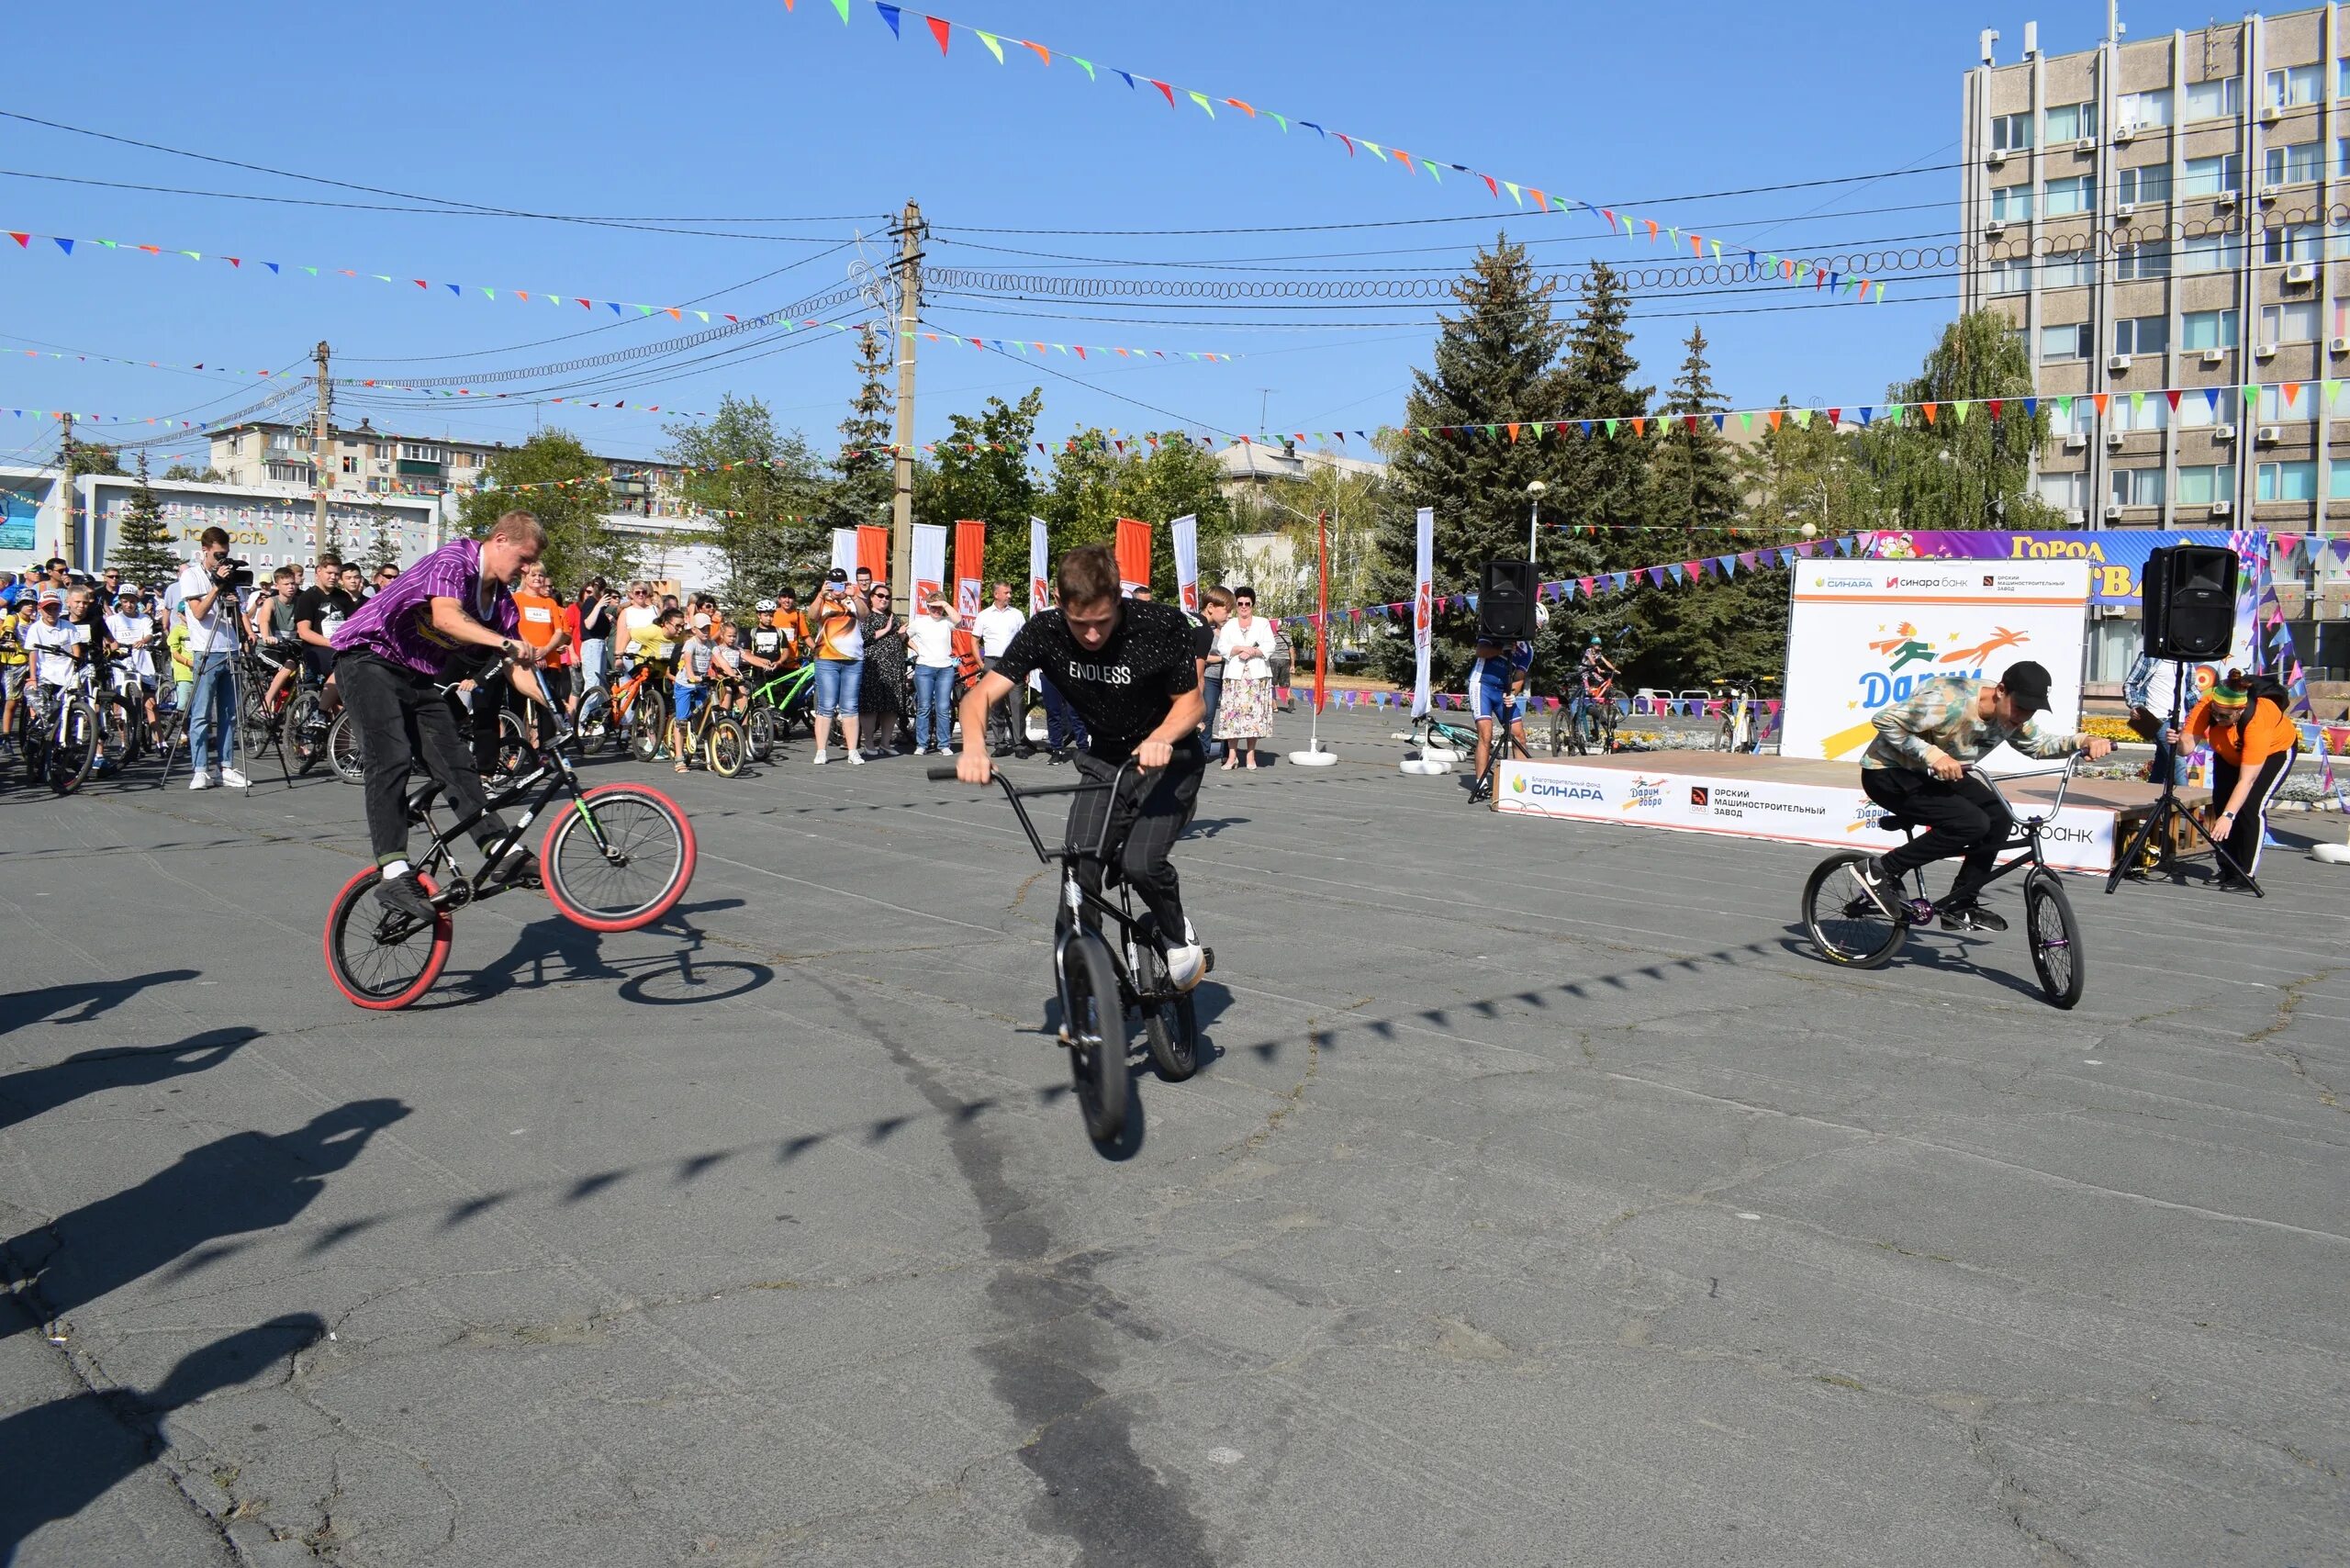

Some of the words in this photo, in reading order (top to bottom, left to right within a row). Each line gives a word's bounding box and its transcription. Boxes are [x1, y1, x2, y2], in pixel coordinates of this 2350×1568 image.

[1827, 580, 1874, 588] СИНАРА
[1899, 578, 1941, 588] синара
[1941, 577, 1968, 588] банк
[1069, 661, 1132, 685] ENDLESS
[1531, 784, 1605, 801] СИНАРА
[1714, 789, 1750, 799] ОРСКИЙ
[1639, 797, 1662, 809] добро
[1714, 798, 1827, 815] МАШИНОСТРОИТЕЛЬНЫЙ
[1714, 808, 1743, 818] ЗАВОД
